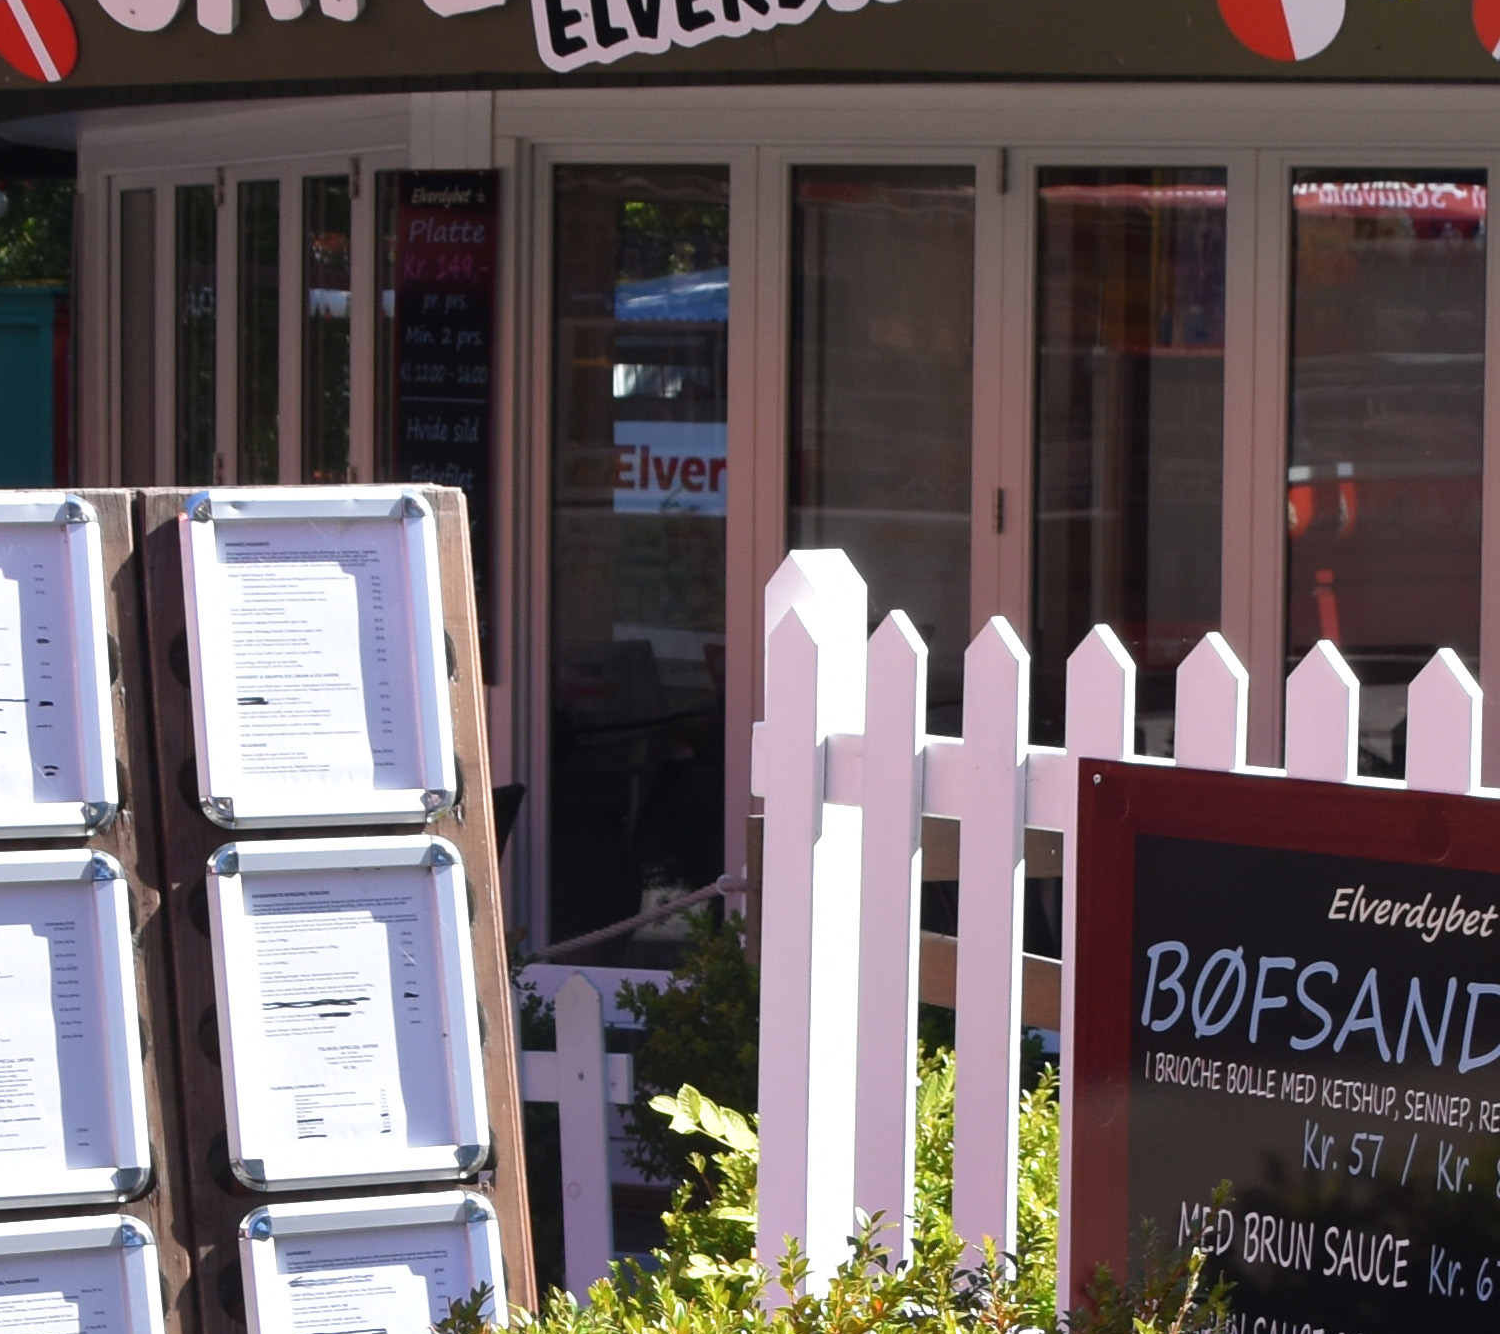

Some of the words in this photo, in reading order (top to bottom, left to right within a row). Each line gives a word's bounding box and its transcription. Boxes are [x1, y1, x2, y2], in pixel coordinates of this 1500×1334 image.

[409, 217, 485, 244] Platte
[404, 253, 428, 279] Kr.
[440, 327, 452, 345] 2
[407, 415, 449, 441] Hvide
[453, 416, 479, 443] sild
[613, 445, 727, 492] Elver
[1327, 885, 1499, 943] Elverdybet
[1145, 1051, 1150, 1078] I
[1155, 1052, 1222, 1090] BRIOCHE
[1226, 1062, 1276, 1098] BOLLE
[1280, 1071, 1317, 1104] MED
[1321, 1077, 1399, 1121] KETSHUP,
[1404, 1089, 1475, 1133] SENNEP,
[1302, 1119, 1338, 1171] Kr.
[1348, 1132, 1384, 1178] 57
[1401, 1132, 1418, 1186] /
[1436, 1140, 1473, 1193] Kr.
[1178, 1200, 1234, 1257] MED
[1243, 1212, 1314, 1271] BRUN
[1322, 1226, 1410, 1289] SAUCE
[1429, 1244, 1465, 1297] Kr.
